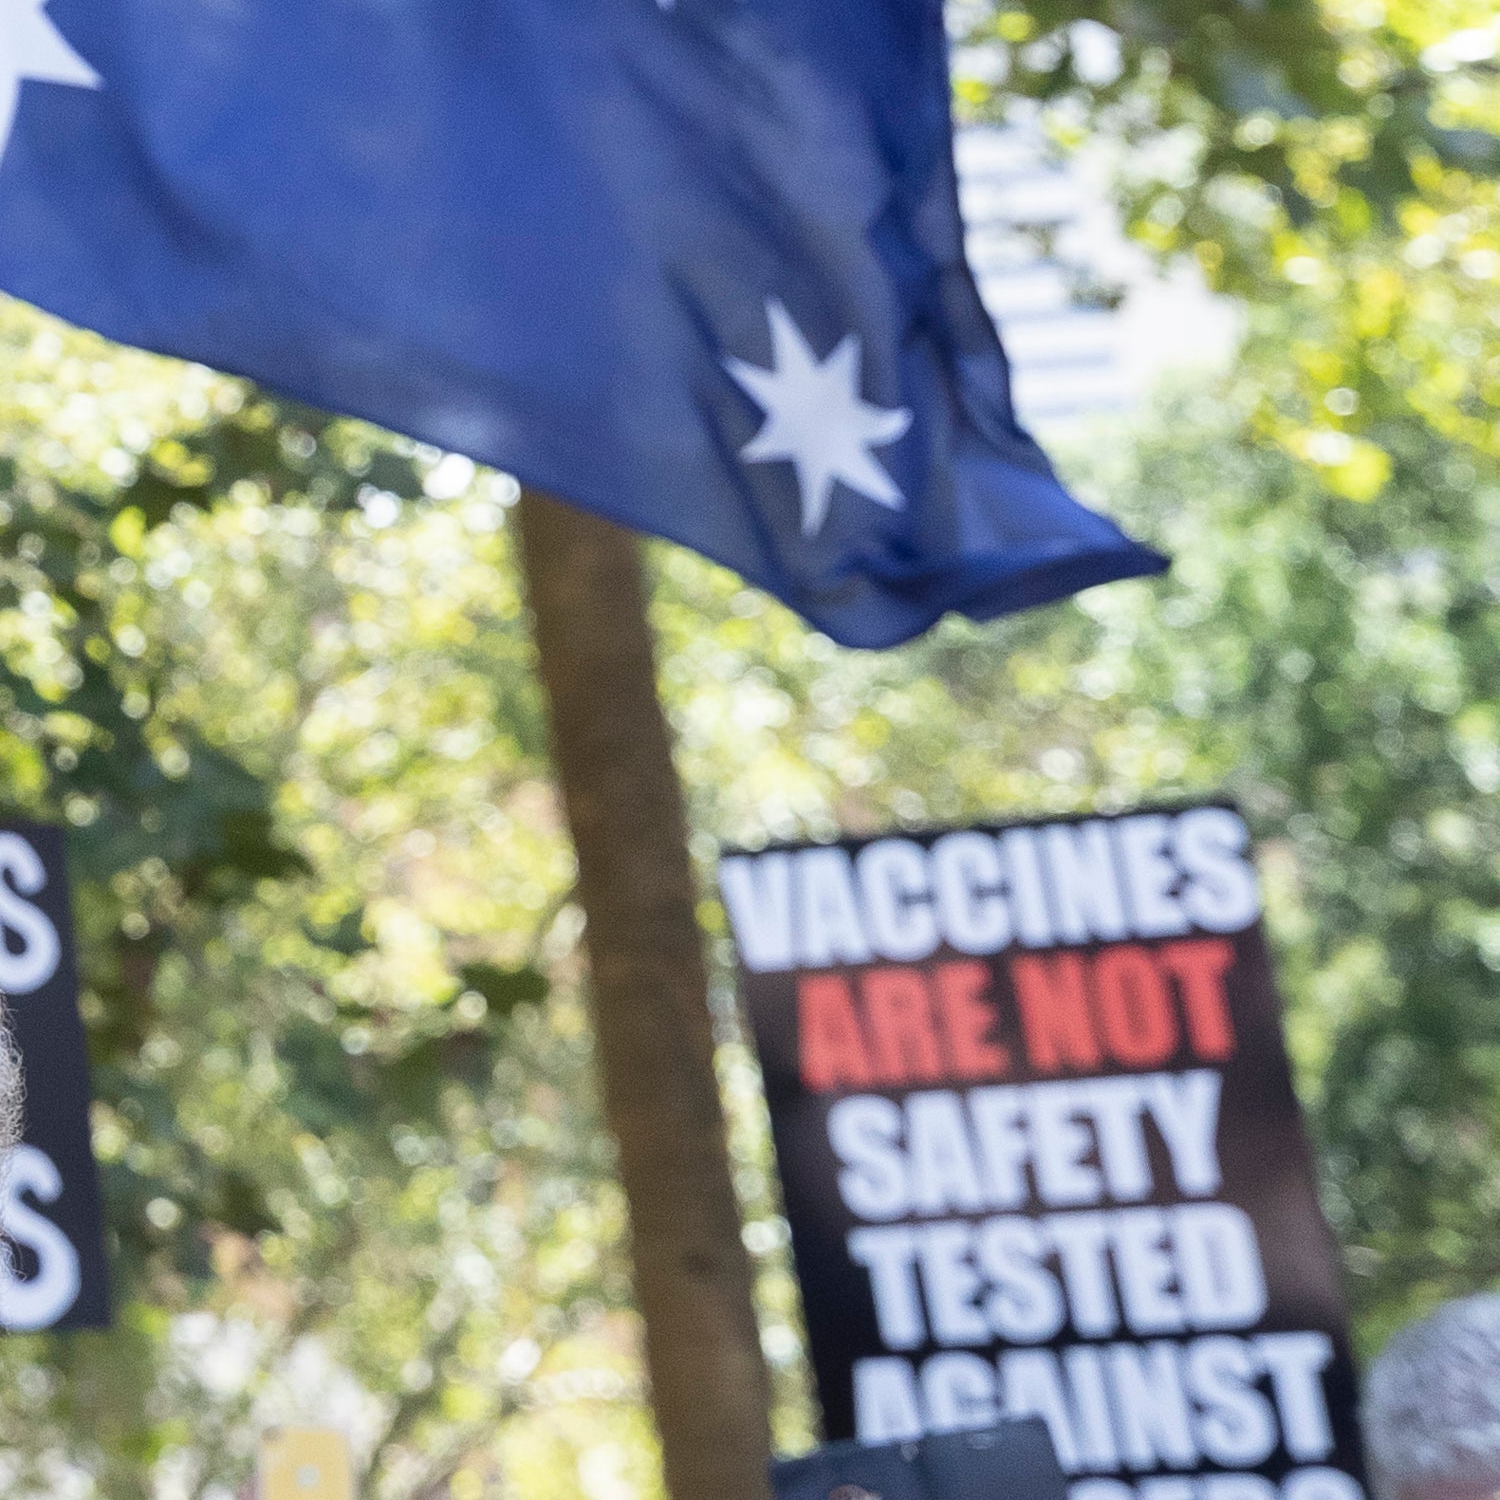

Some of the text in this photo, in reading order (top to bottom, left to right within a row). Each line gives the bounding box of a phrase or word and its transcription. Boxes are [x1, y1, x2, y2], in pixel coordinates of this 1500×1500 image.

[720, 806, 1260, 973] VACCINES
[799, 939, 1236, 1092] ARE NOT
[827, 1069, 1222, 1222] SAFETY
[847, 1202, 1269, 1351] TESTED
